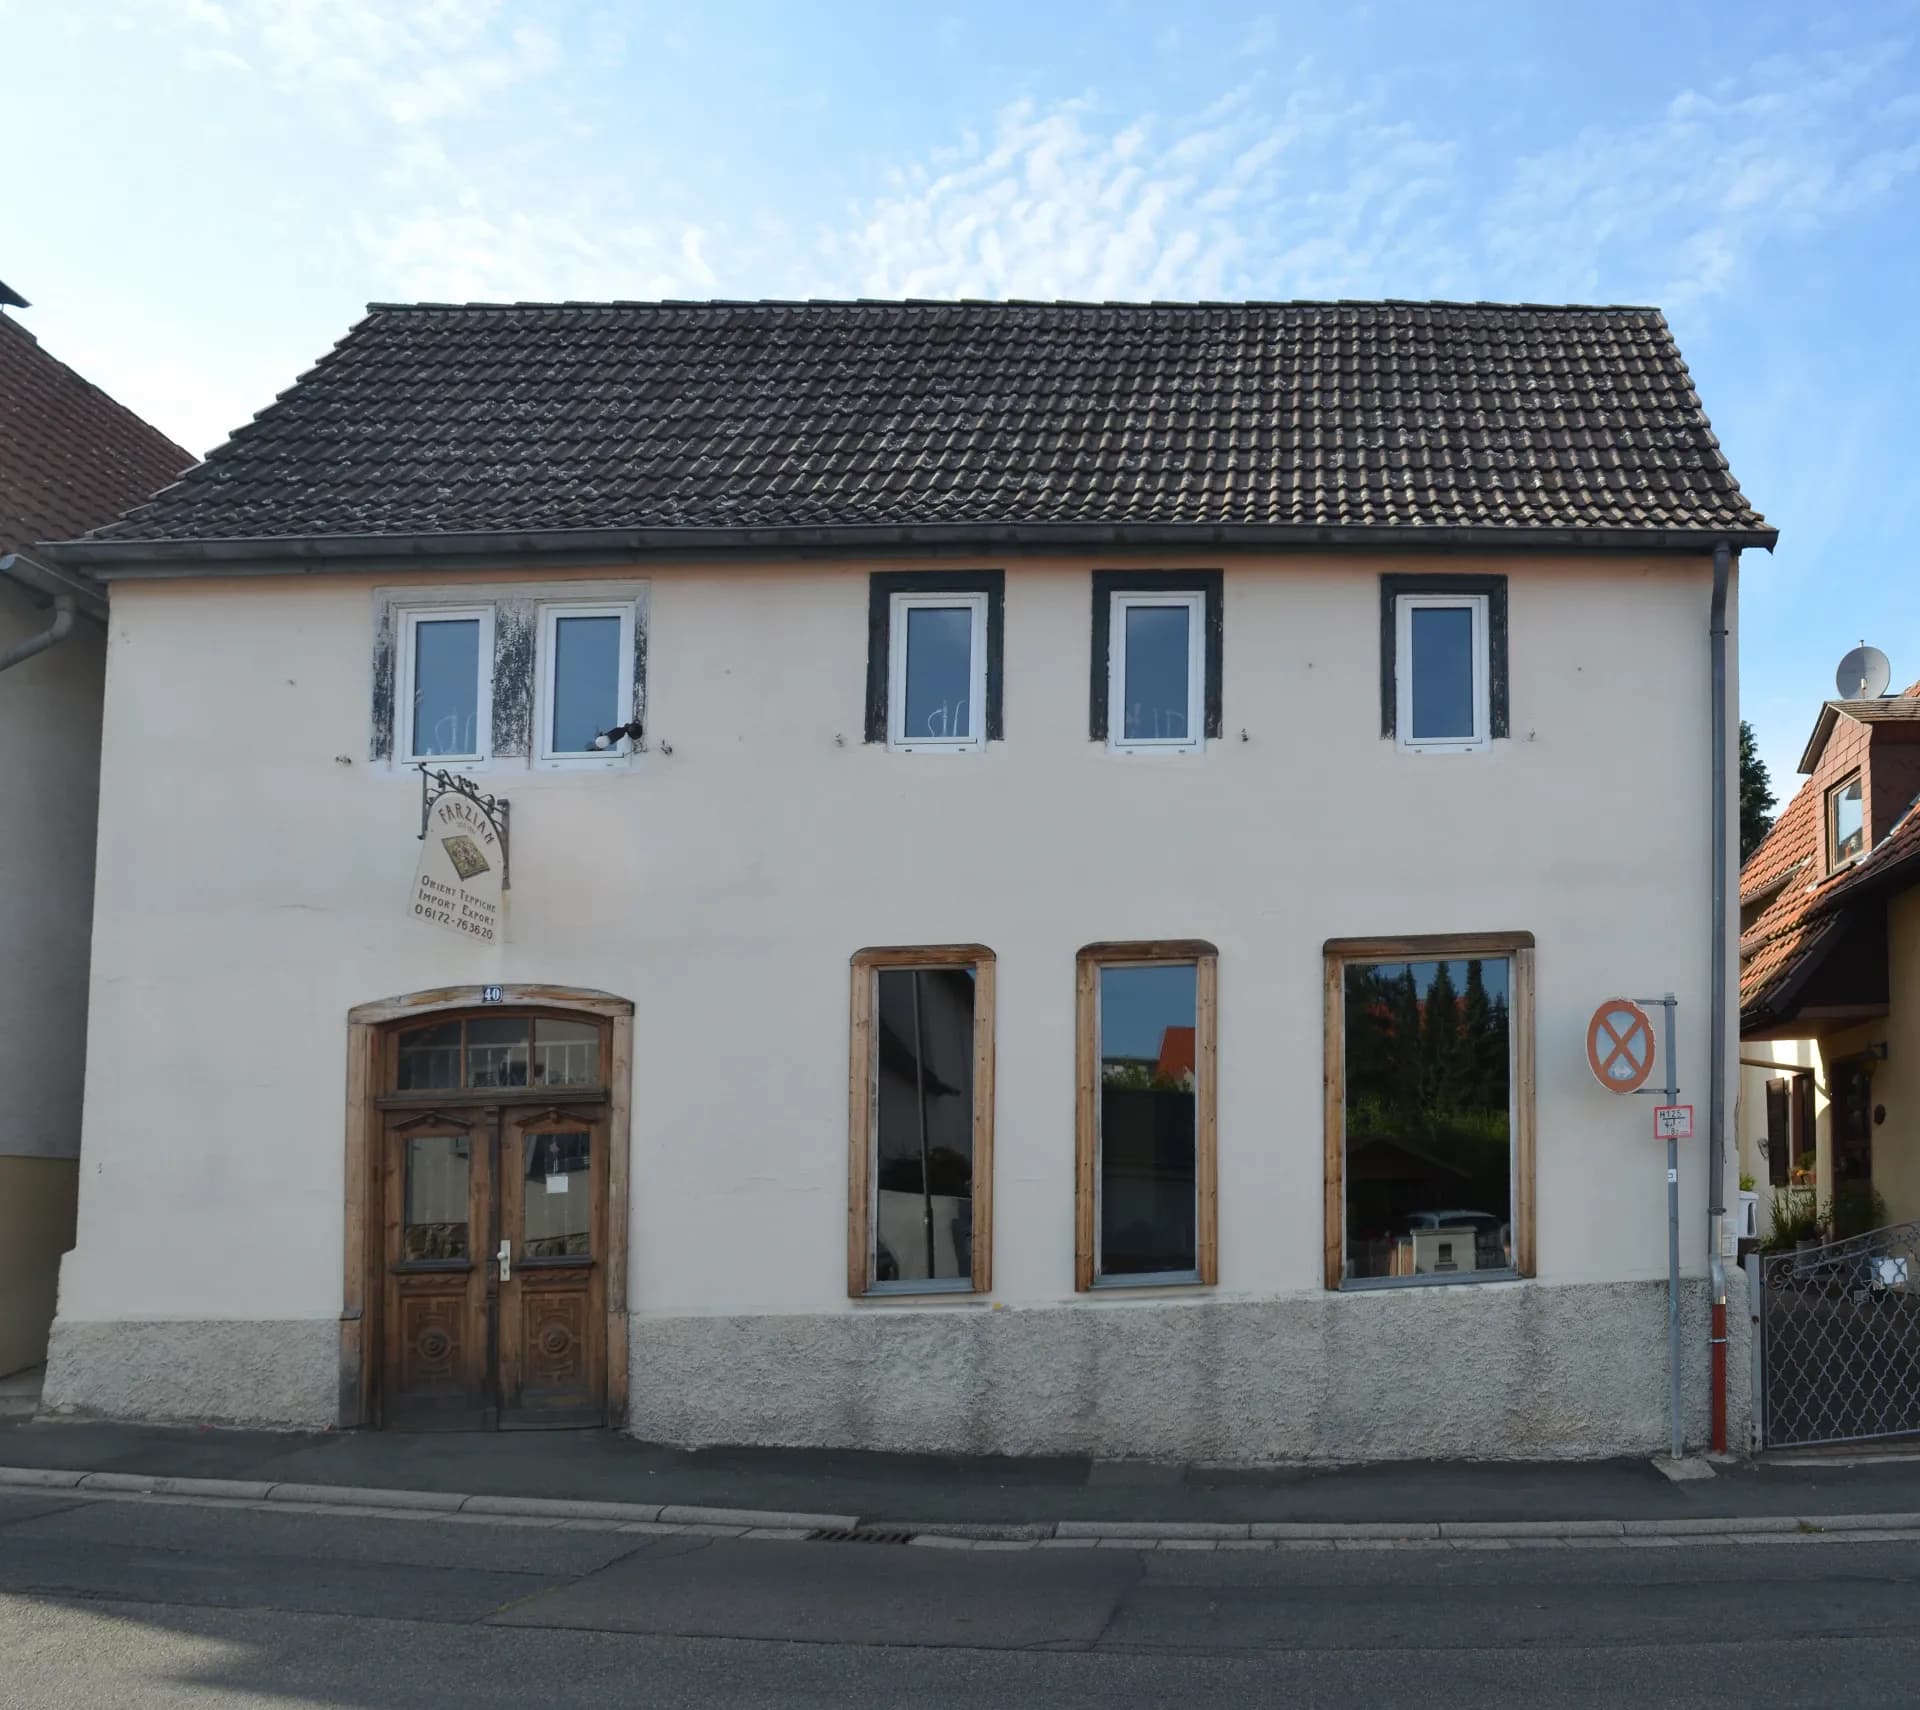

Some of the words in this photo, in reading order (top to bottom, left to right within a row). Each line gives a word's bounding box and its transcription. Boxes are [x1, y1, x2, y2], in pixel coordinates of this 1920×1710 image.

[438, 802, 495, 844] FARZIAN
[418, 888, 456, 911] IMPORT
[462, 904, 494, 926] EXPORT
[421, 875, 456, 897] ORIENT
[460, 888, 496, 913] TEPPICHE
[484, 988, 500, 1001] 40
